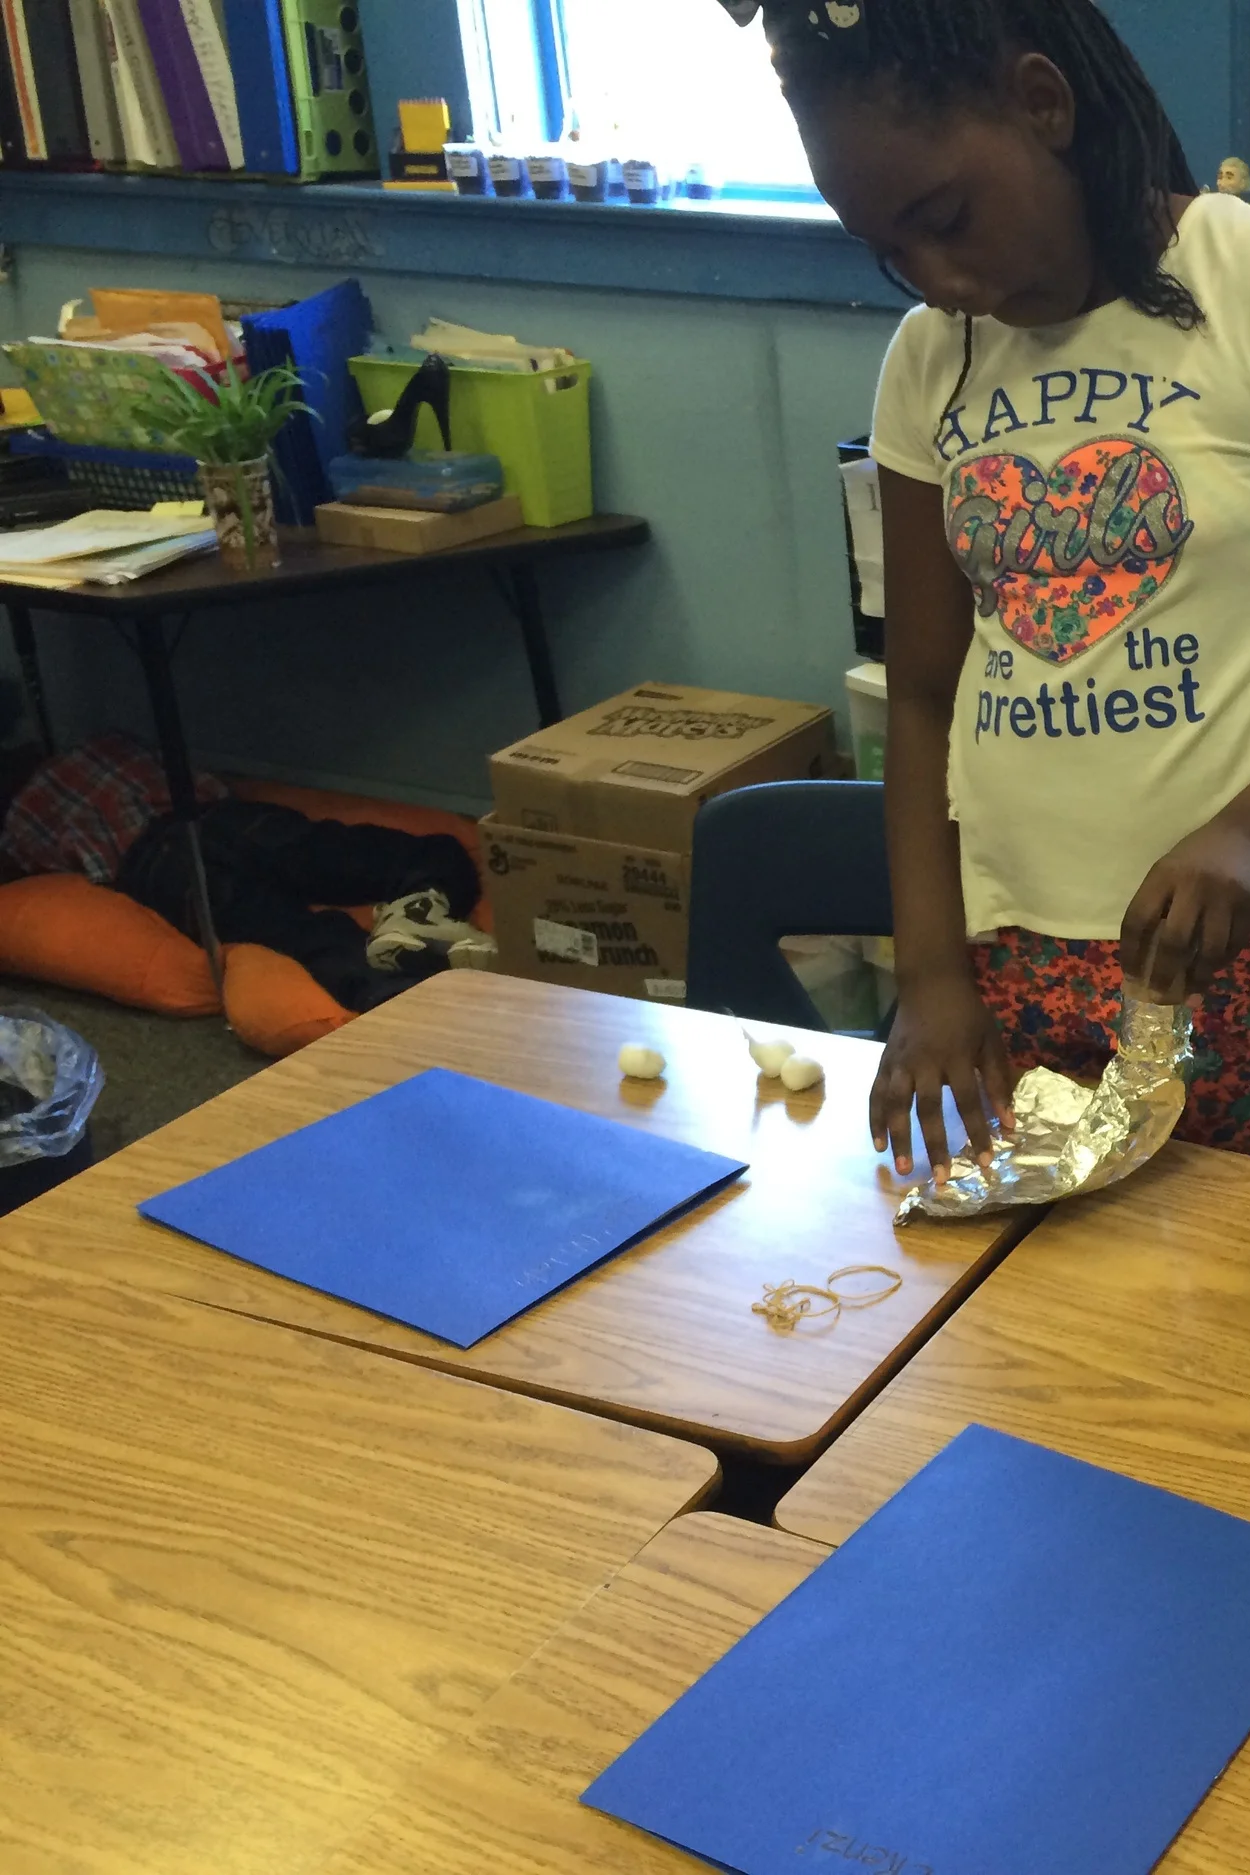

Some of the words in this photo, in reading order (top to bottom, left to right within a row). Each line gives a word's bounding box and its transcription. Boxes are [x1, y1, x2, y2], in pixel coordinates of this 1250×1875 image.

[934, 368, 1201, 462] HAPPY
[984, 647, 1015, 681] are
[1124, 628, 1201, 671] the
[975, 667, 1206, 745] prettiest
[599, 943, 659, 966] runch
